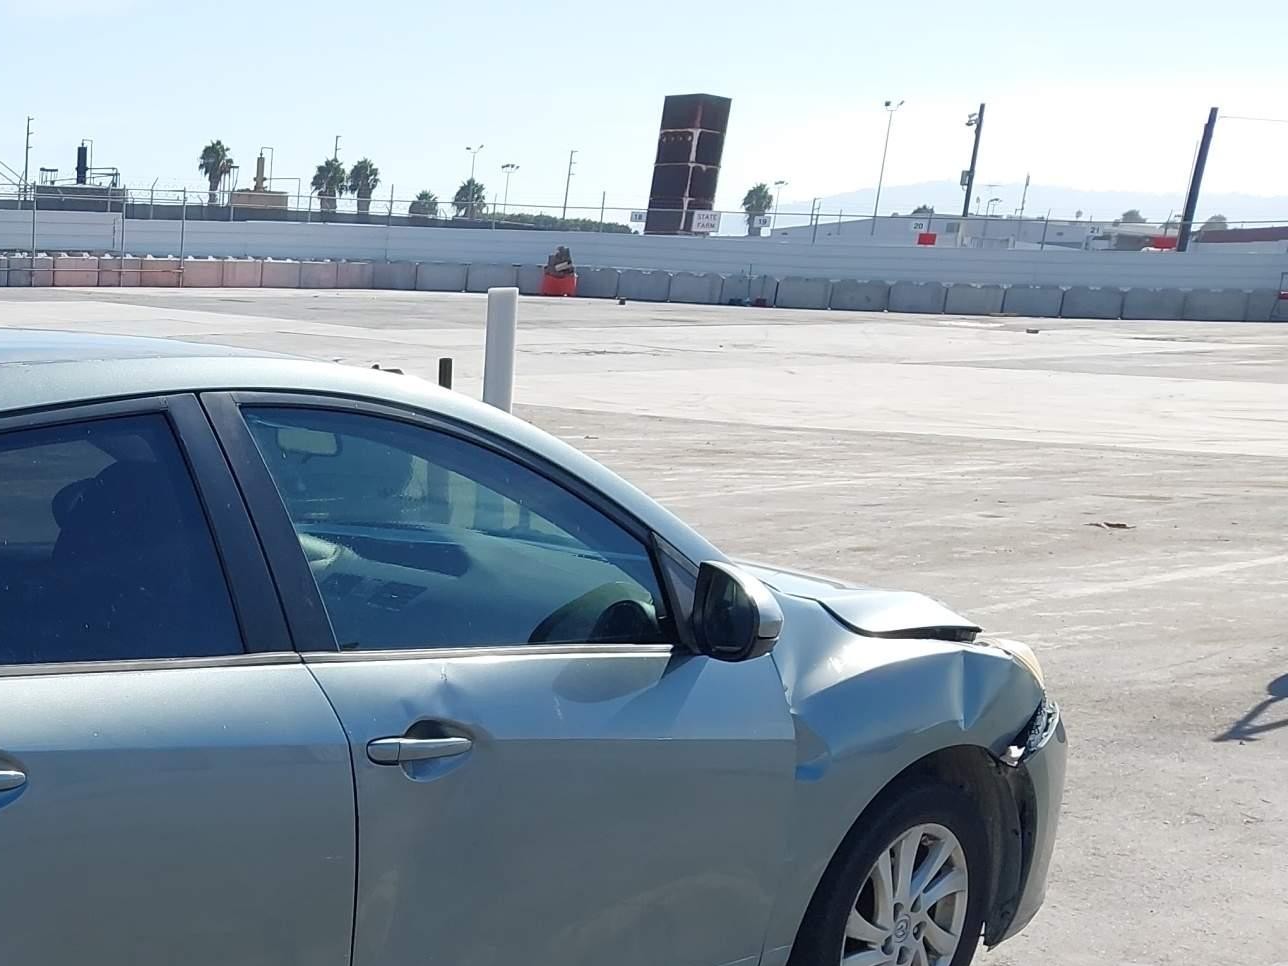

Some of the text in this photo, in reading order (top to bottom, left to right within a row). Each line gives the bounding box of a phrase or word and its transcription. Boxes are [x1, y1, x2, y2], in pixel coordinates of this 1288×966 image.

[697, 213, 718, 221] STATE
[696, 222, 716, 230] FARM
[758, 218, 767, 226] 19
[913, 222, 924, 230] 20
[1090, 226, 1100, 234] 21
